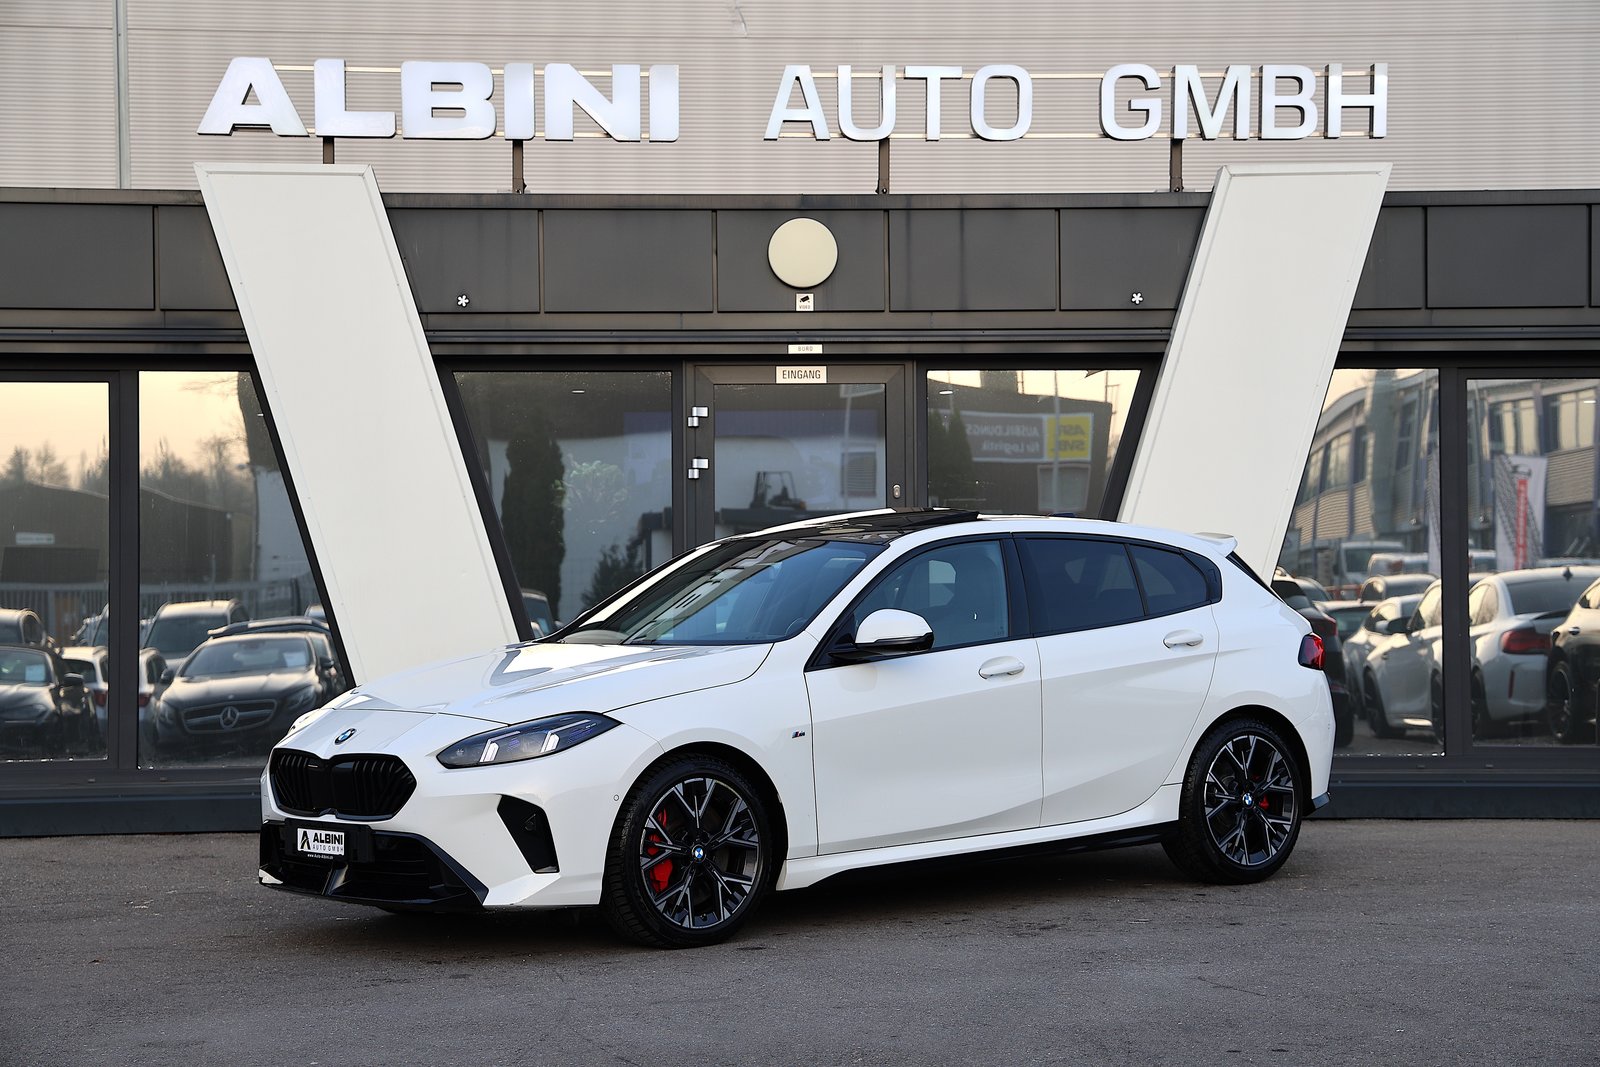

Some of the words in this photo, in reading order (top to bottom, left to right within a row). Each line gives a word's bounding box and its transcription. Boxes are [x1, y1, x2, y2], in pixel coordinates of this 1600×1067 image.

[197, 57, 680, 142] ALBINI
[764, 64, 1034, 141] AUTO
[1100, 63, 1388, 141] GMBH
[782, 370, 821, 379] EINGANG
[313, 832, 343, 845] ALBINI
